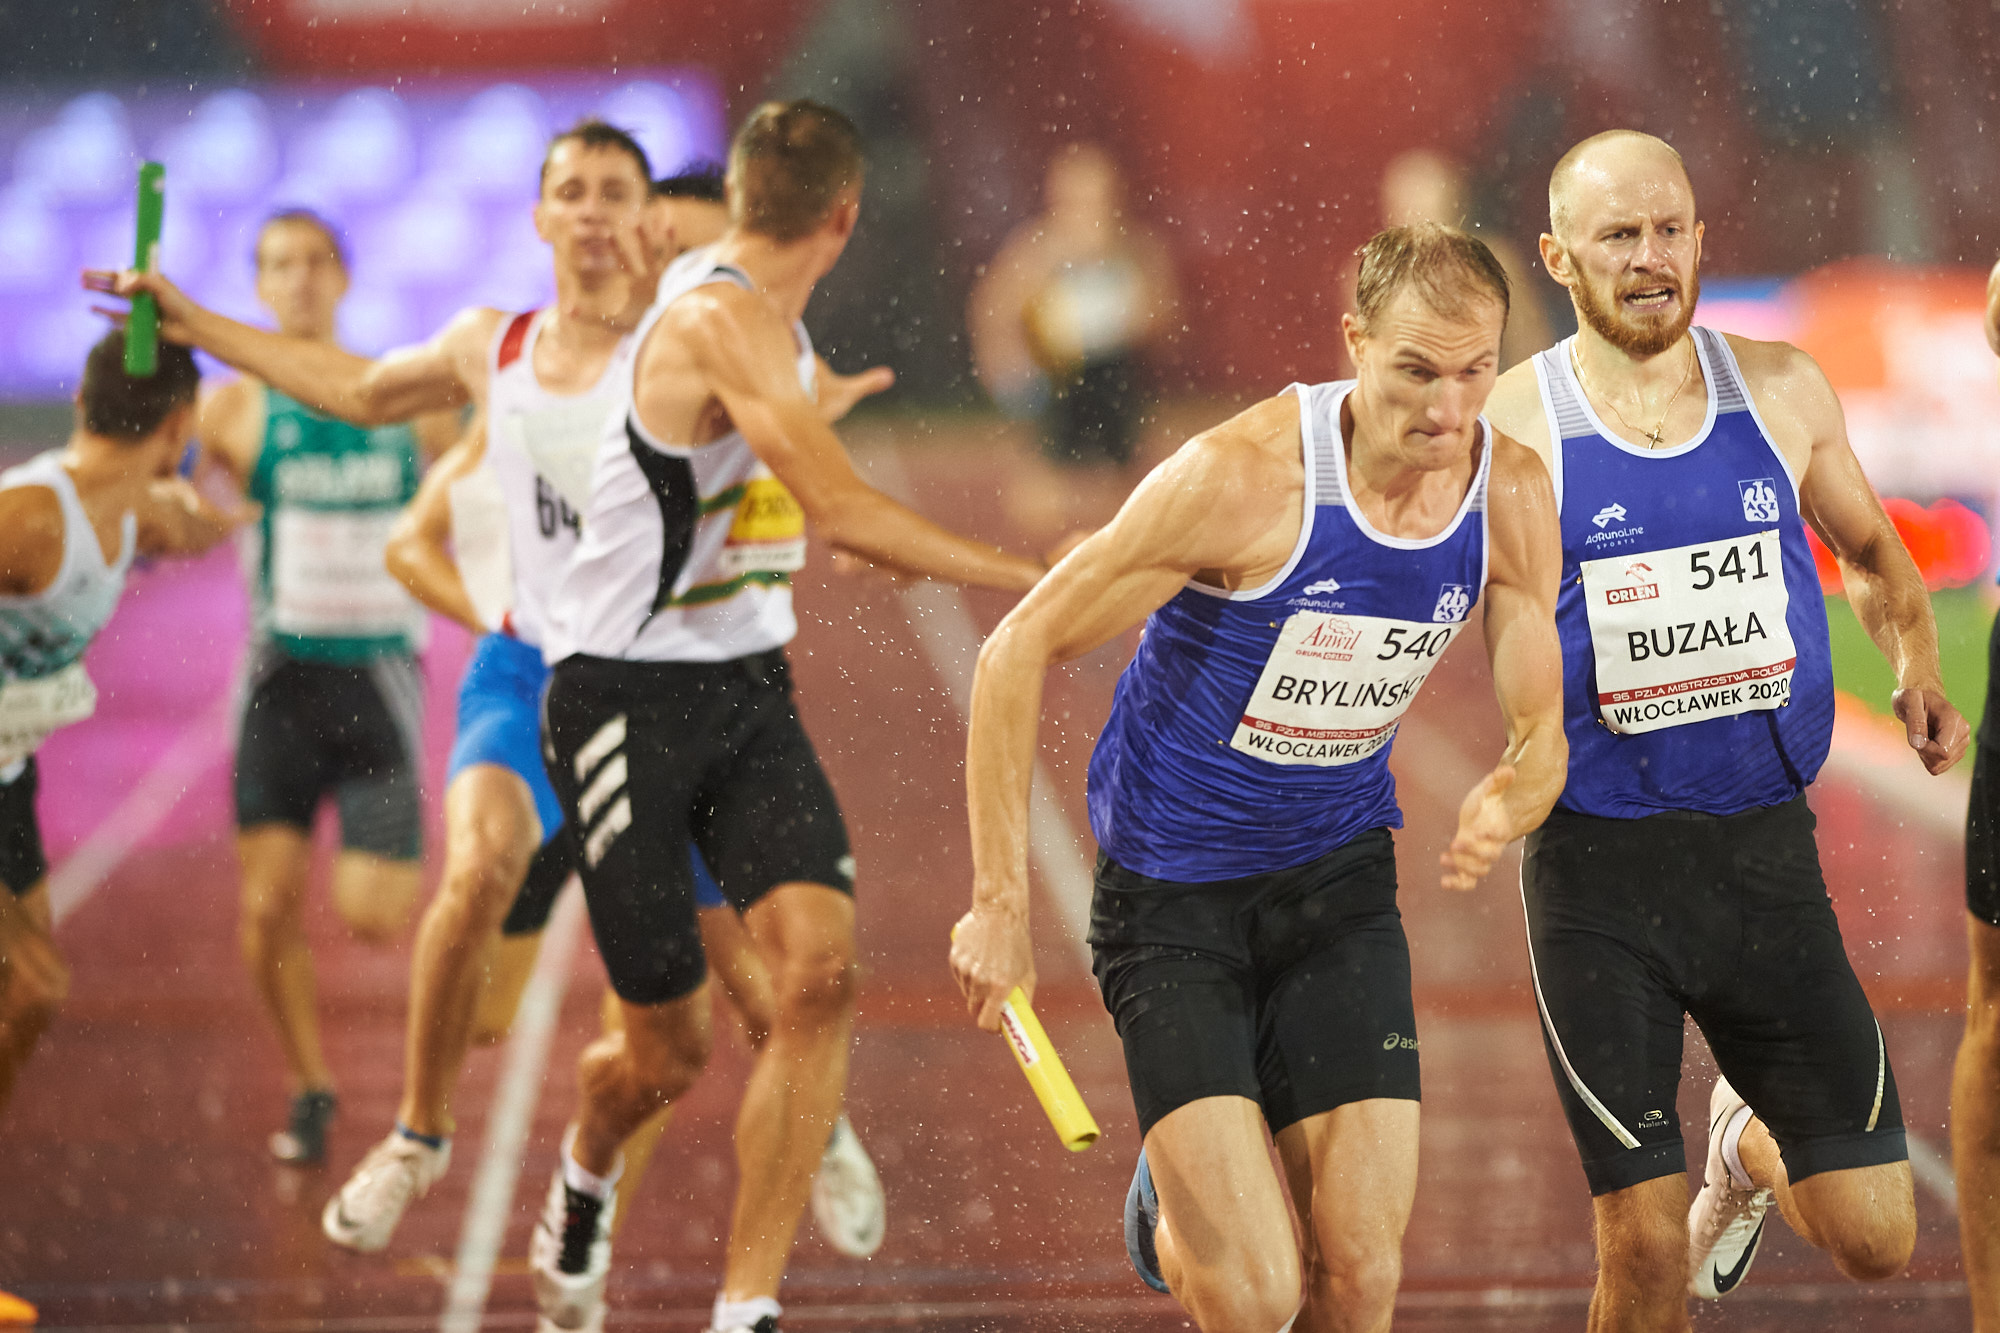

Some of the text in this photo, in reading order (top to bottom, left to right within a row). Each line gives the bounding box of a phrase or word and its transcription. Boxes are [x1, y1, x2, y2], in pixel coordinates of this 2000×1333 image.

[1690, 541, 1769, 590] 541
[1608, 585, 1657, 604] ORLEN
[1300, 621, 1362, 650] Anwil
[1376, 627, 1451, 661] 540
[1628, 611, 1767, 662] BUZAŁA
[1634, 687, 1666, 699] PZLA
[1667, 671, 1749, 693] MISTRZOSTWA
[1751, 662, 1787, 678] POLSKI
[1613, 677, 1788, 725] WŁOCŁAWEK 2020
[1248, 733, 1365, 758] WŁOCŁAWEK
[1276, 726, 1304, 737] PZLA
